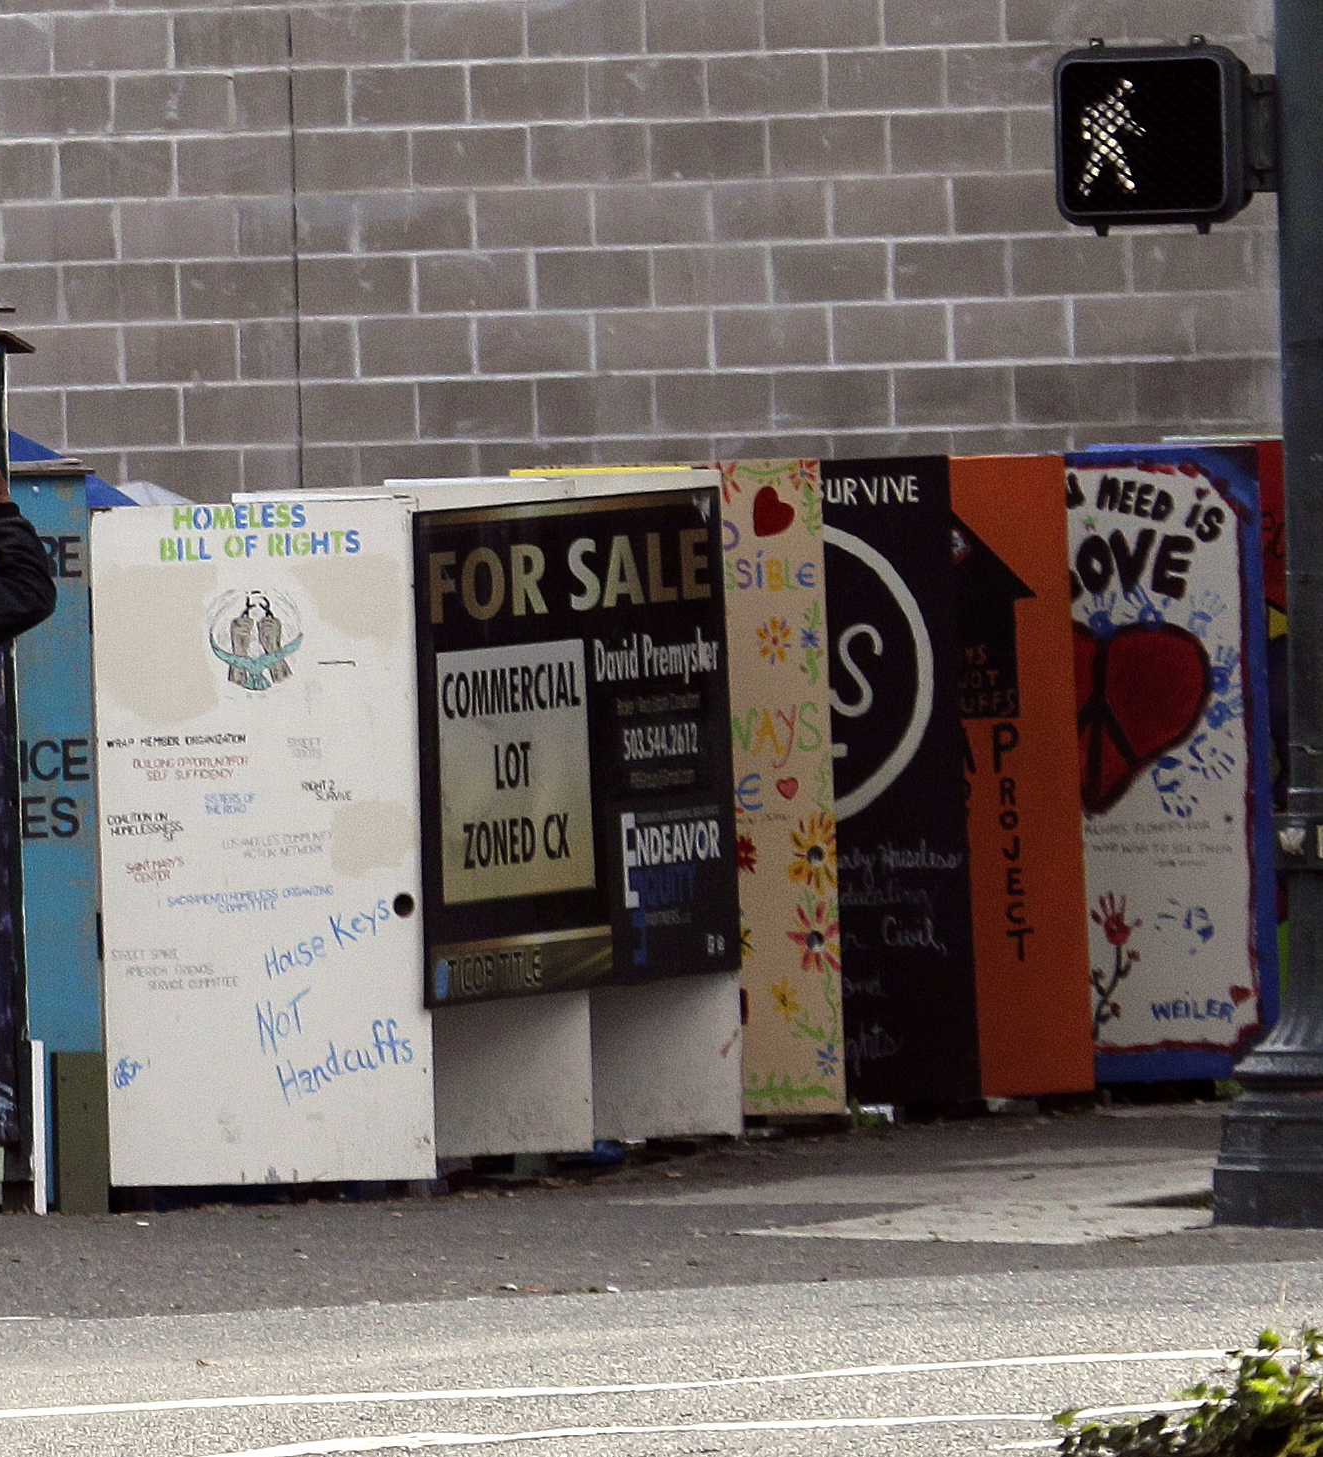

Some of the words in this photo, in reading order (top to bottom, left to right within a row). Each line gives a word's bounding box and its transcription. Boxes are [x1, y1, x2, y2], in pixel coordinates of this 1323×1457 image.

[820, 474, 919, 506] URVIVE
[1096, 474, 1175, 523] NEED
[174, 503, 307, 531] HOMELESS
[159, 535, 213, 562] BILL
[224, 534, 259, 559] OF
[267, 529, 362, 556] RIGHTS
[428, 543, 549, 625] FOR
[567, 527, 713, 613] SALE
[592, 632, 639, 683] David
[442, 660, 581, 720] COMMERCIAL
[494, 740, 531, 790] LOT
[463, 816, 537, 870] ZONED
[543, 812, 571, 860] CX
[991, 721, 1035, 962] PROJECT
[264, 933, 328, 981] House
[329, 899, 391, 949] Keys
[1151, 998, 1235, 1025] WEILER
[276, 1017, 415, 1106] Handcuffs
